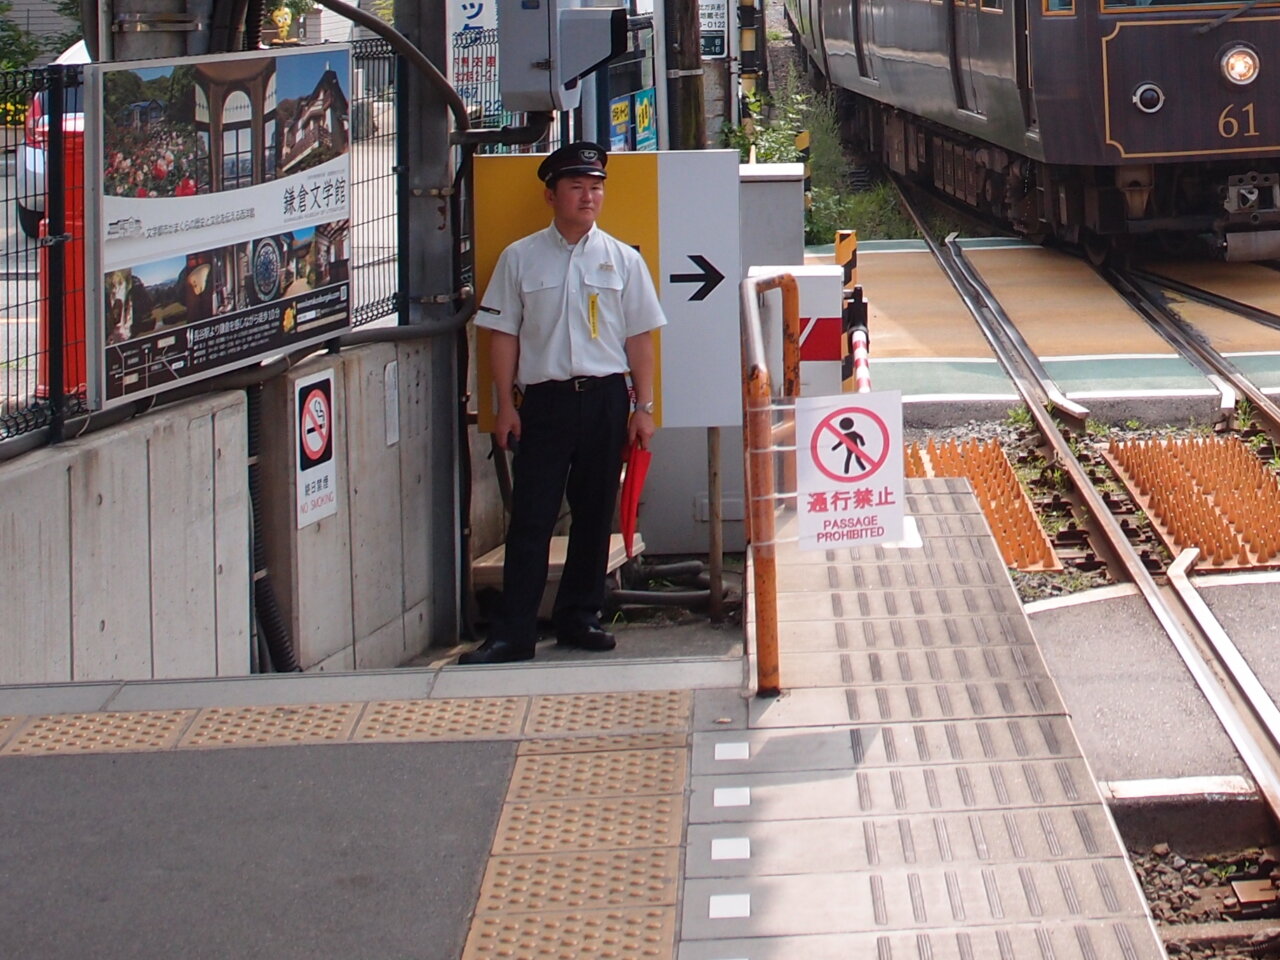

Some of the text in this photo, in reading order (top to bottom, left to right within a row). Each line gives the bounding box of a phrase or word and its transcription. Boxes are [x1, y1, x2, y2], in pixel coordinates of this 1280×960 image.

[1218, 102, 1260, 138] 61
[283, 177, 346, 215] 鎌倉文学館
[300, 491, 335, 515] NO SMOKING
[807, 486, 896, 513] 通行禁止
[816, 526, 885, 543] PROHIBITED
[823, 515, 878, 530] PASSAGE
